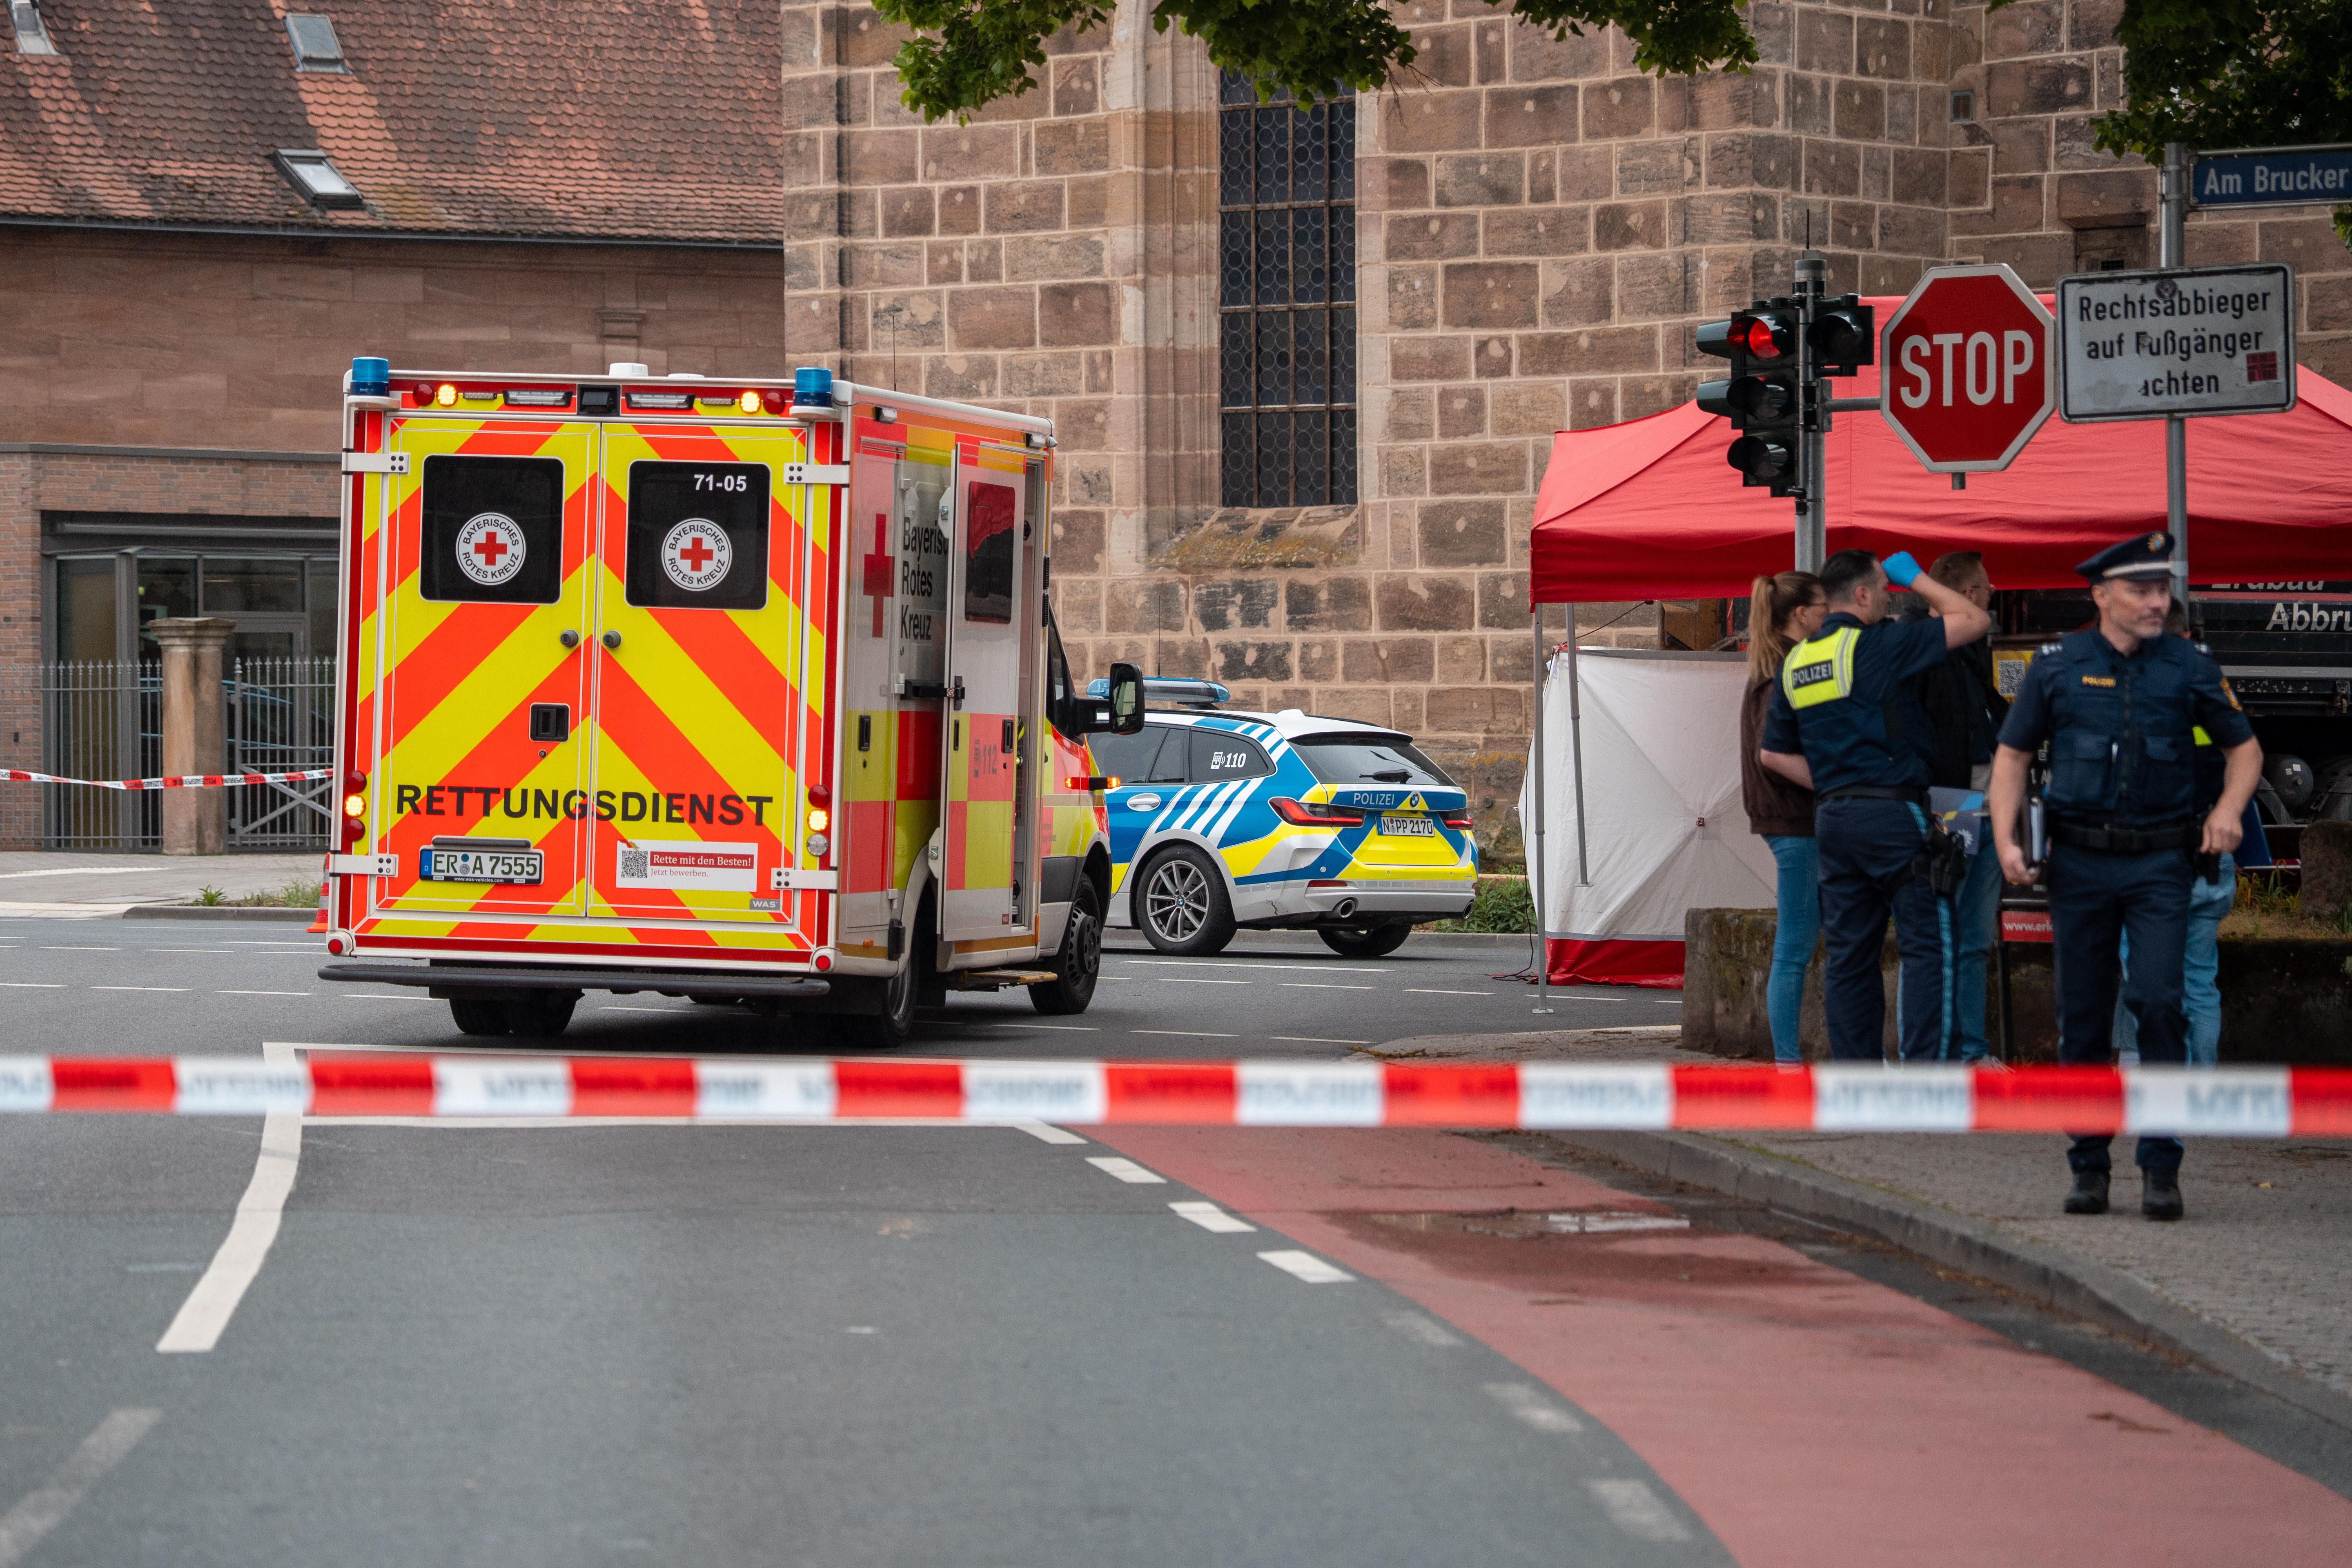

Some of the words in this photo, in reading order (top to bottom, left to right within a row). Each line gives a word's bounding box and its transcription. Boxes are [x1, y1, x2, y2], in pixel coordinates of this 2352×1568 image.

[2204, 167, 2242, 194] Am
[2254, 163, 2349, 192] Brucker
[2079, 288, 2271, 321] Rechtsabbieger
[2087, 333, 2125, 359] auf
[2135, 327, 2263, 361] Fußgänger
[1900, 330, 2034, 408] STOP
[694, 474, 746, 491] 71-05
[463, 519, 519, 546] BAYERISCHES
[668, 524, 725, 552] BAYERISCHES
[462, 552, 488, 579] ROTES
[491, 553, 519, 579] KREUZ
[668, 557, 694, 584] ROTES
[697, 559, 725, 585] KREUZ
[902, 560, 933, 597] Rotes
[900, 604, 931, 640] Kreuz
[1793, 662, 1832, 686] POLIZEI
[983, 745, 997, 775] 112
[1224, 753, 1247, 768] 110
[396, 784, 773, 826] RETTUNGSDIENST
[1353, 793, 1394, 805] POLIZEI
[1383, 819, 1390, 833] N
[1395, 819, 1408, 833] PP
[1410, 820, 1433, 834] 2170
[433, 854, 458, 873] ER
[472, 855, 483, 874] A
[489, 856, 537, 876] 7555
[653, 855, 677, 864] Rette
[679, 855, 695, 864] mit
[697, 856, 714, 865] den
[717, 857, 751, 866] Besten!
